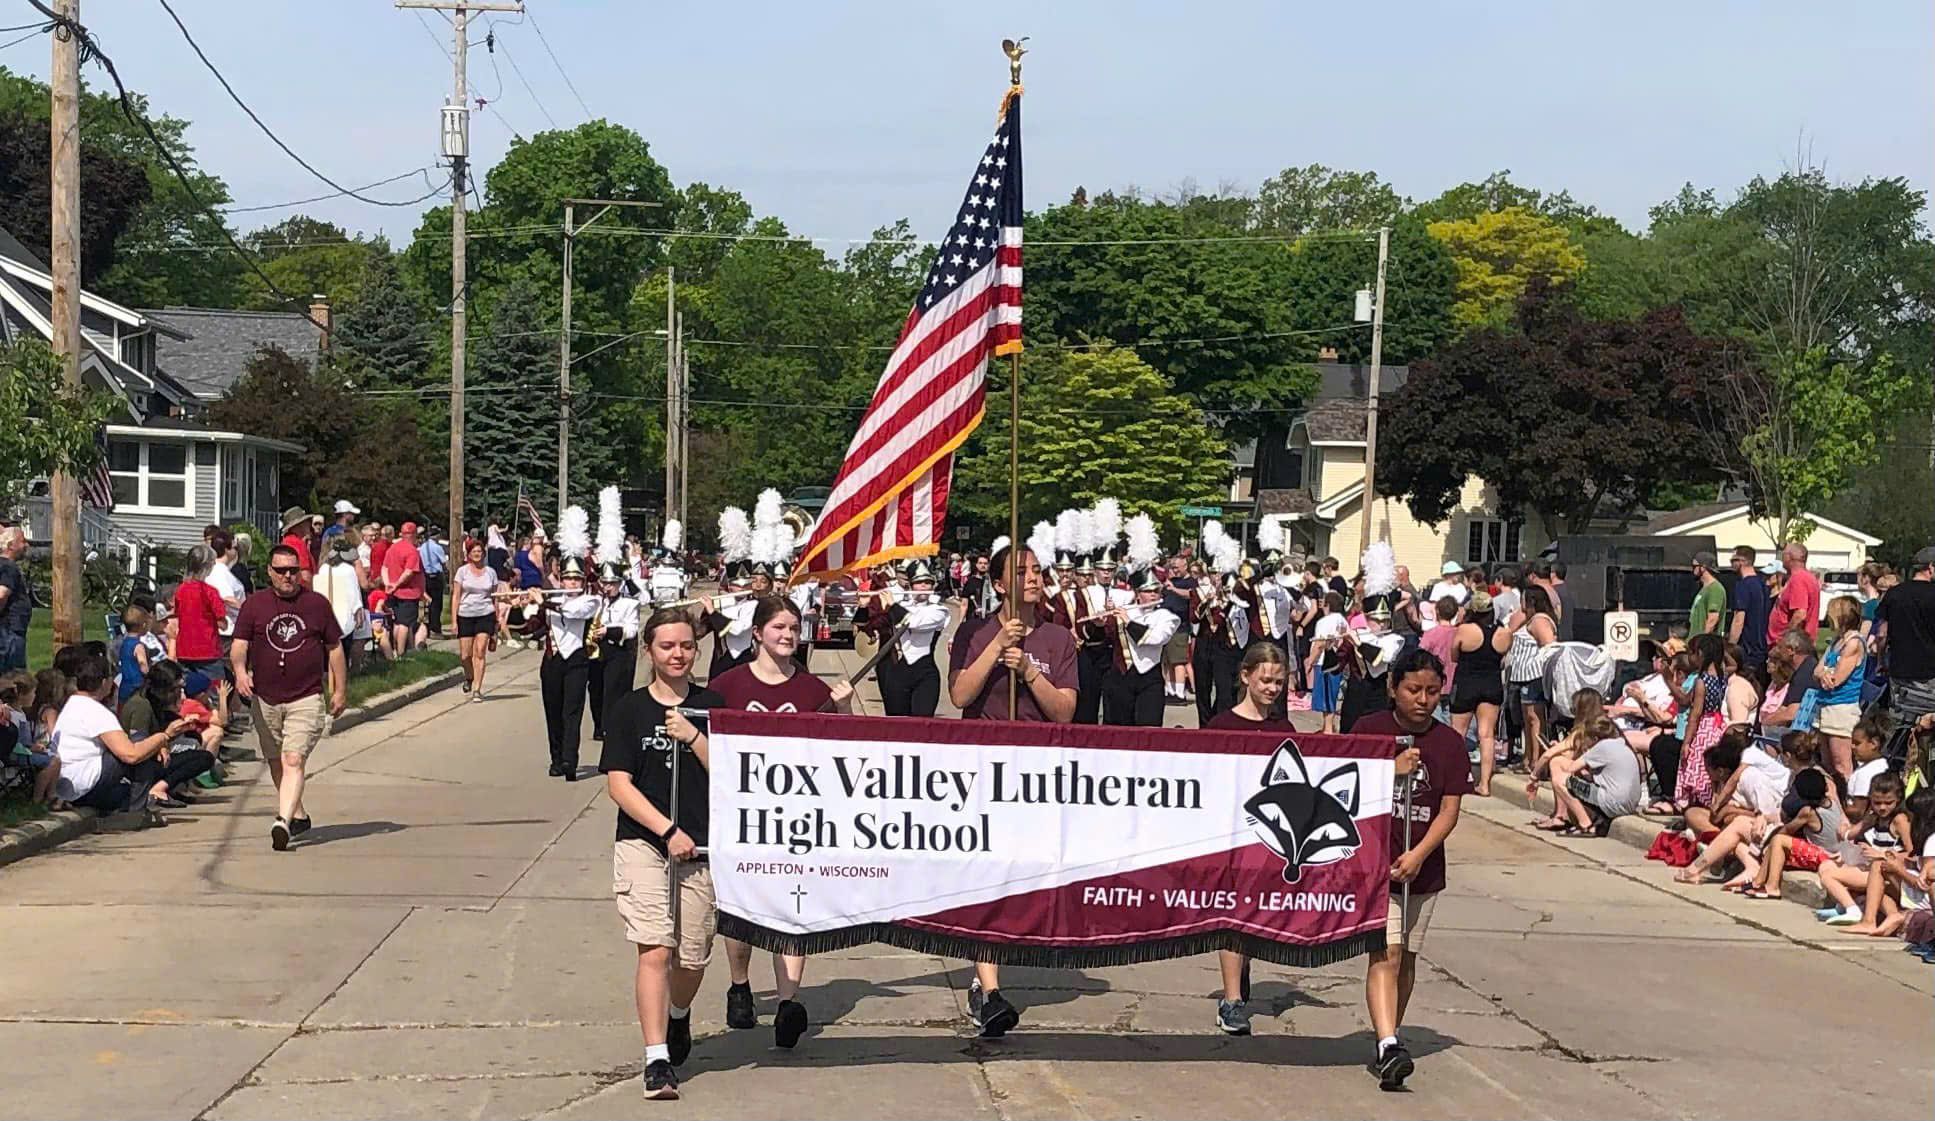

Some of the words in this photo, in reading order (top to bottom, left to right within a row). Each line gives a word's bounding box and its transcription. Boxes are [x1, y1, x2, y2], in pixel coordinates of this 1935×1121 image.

[736, 751, 821, 797] Fox
[832, 754, 978, 812] Valley
[989, 759, 1202, 810] Lutheran
[736, 806, 839, 855] High
[852, 811, 992, 853] School
[735, 861, 805, 876] APPLETON
[818, 865, 890, 879] WISCONSIN
[1083, 886, 1143, 907] FAITH
[1162, 889, 1237, 910] VALUES
[1257, 891, 1356, 913] LEARNING
